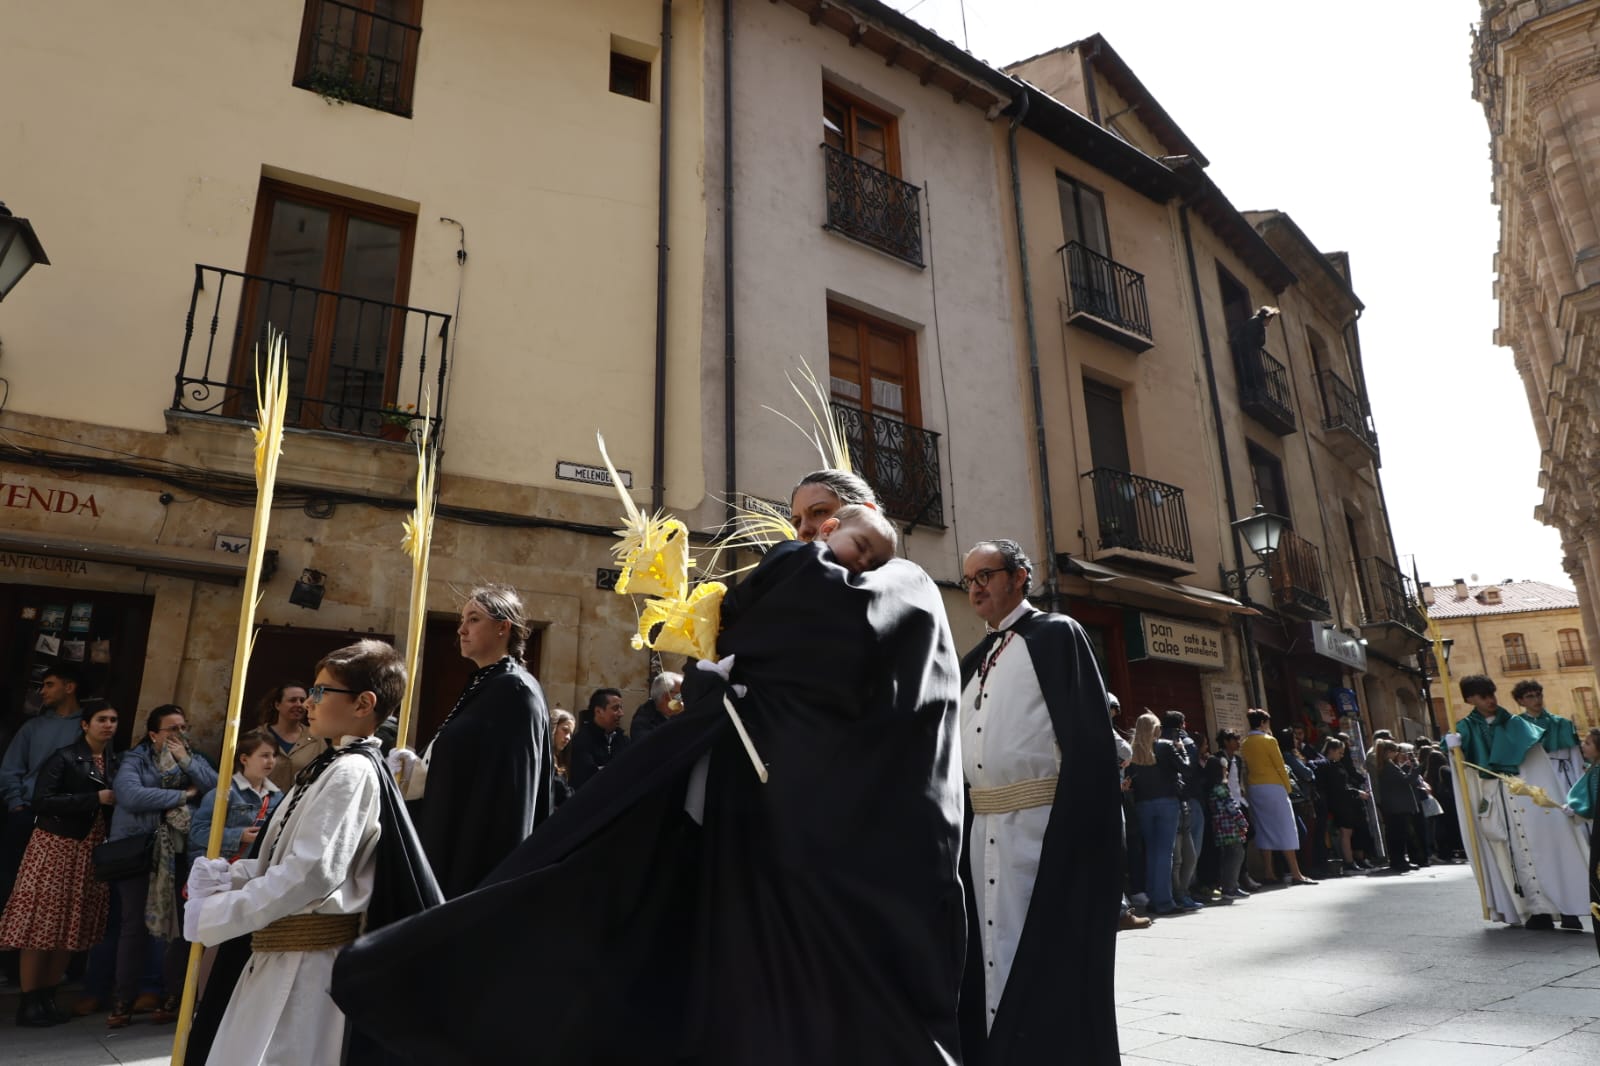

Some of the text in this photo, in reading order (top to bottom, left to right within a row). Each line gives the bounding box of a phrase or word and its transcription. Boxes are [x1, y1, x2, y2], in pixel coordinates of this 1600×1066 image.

[575, 468, 613, 483] MELENDE
[1150, 623, 1174, 638] pan
[1152, 638, 1180, 656] cake
[1201, 636, 1208, 646] &
